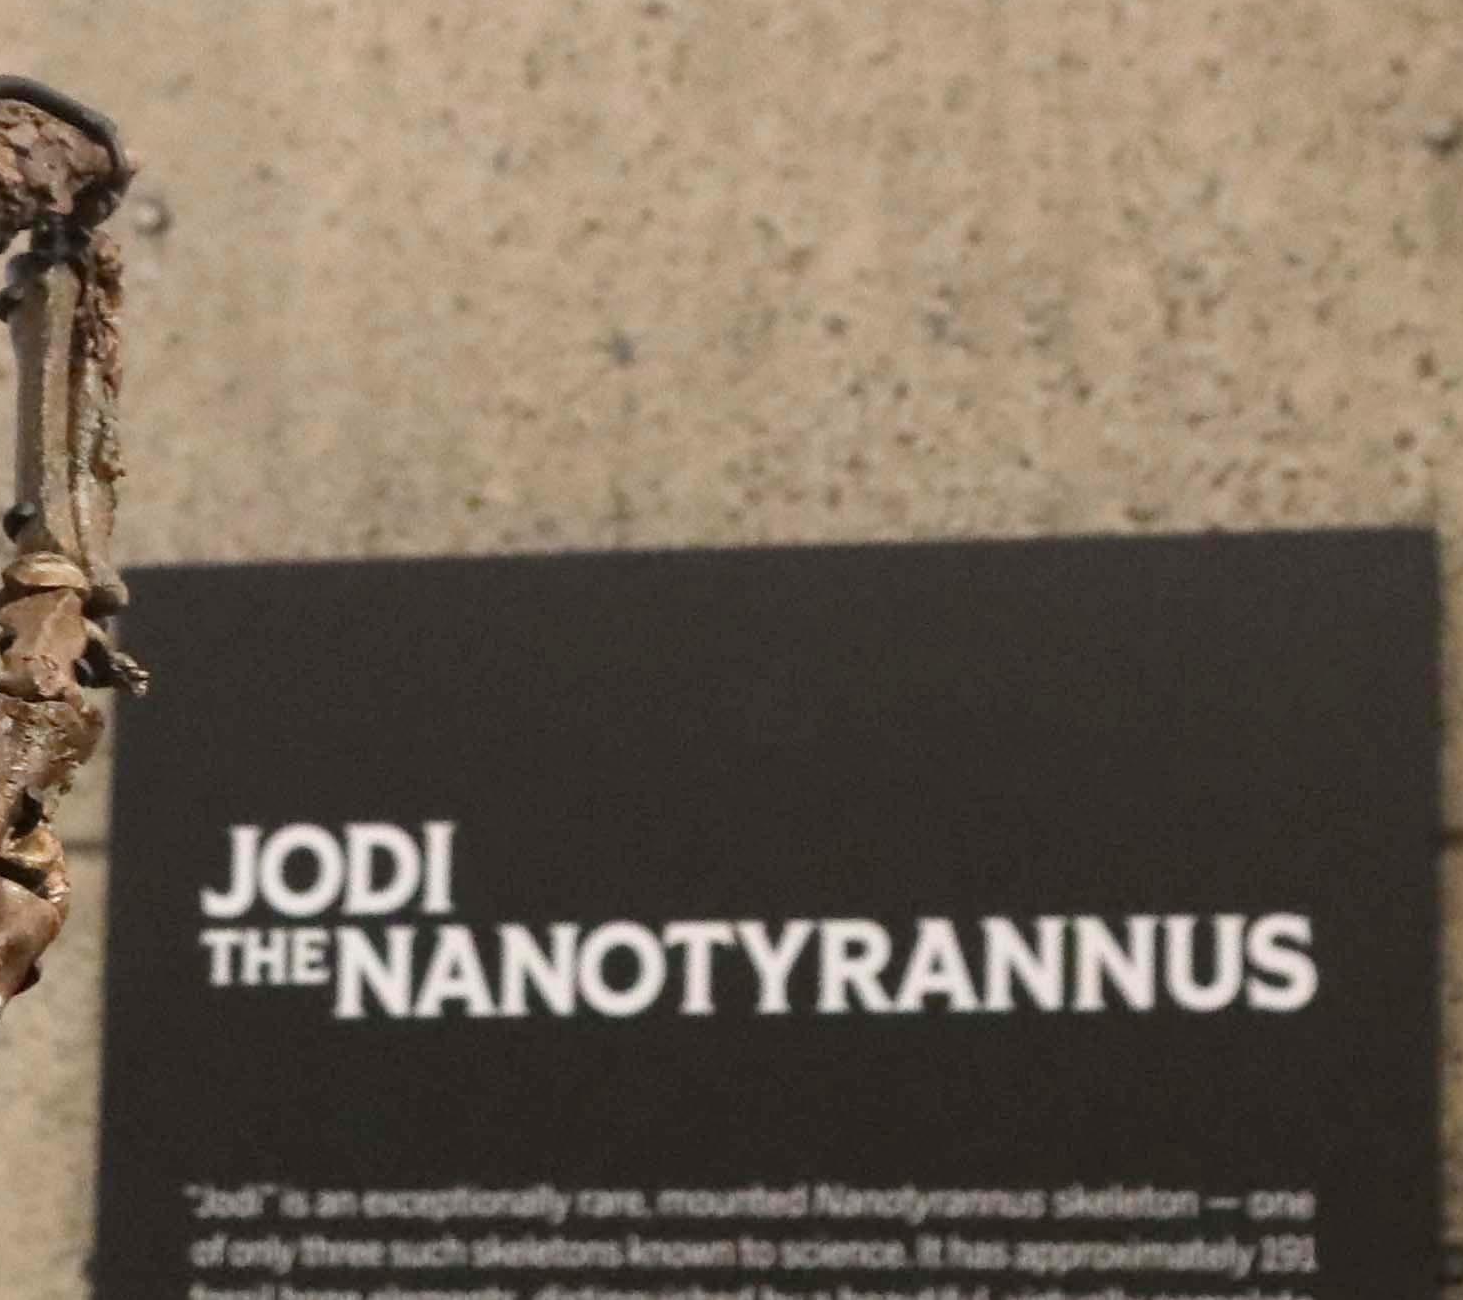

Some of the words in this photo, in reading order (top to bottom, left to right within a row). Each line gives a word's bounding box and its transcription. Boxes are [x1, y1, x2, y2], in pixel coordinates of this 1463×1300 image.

[200, 820, 455, 918] JODI
[199, 927, 330, 986] THE
[333, 914, 1319, 1019] NANOTYRANNUS
[279, 1189, 310, 1218] is
[315, 1191, 358, 1218] an
[361, 1184, 571, 1225] exceptionally
[577, 1191, 650, 1220] rare,
[656, 1185, 808, 1219] mounted
[814, 1184, 1045, 1224] Nanotyrannus
[1053, 1185, 1199, 1219] skeleton
[1247, 1191, 1315, 1219] one
[190, 1234, 226, 1267] of
[228, 1235, 295, 1274] only
[299, 1235, 385, 1267] three
[389, 1235, 467, 1267] such
[471, 1235, 624, 1267] skeletons
[627, 1235, 735, 1267] known
[738, 1236, 775, 1268] to
[779, 1238, 906, 1269] science.
[917, 1235, 943, 1268] It
[946, 1235, 1010, 1269] has
[1014, 1235, 1256, 1278] approximately
